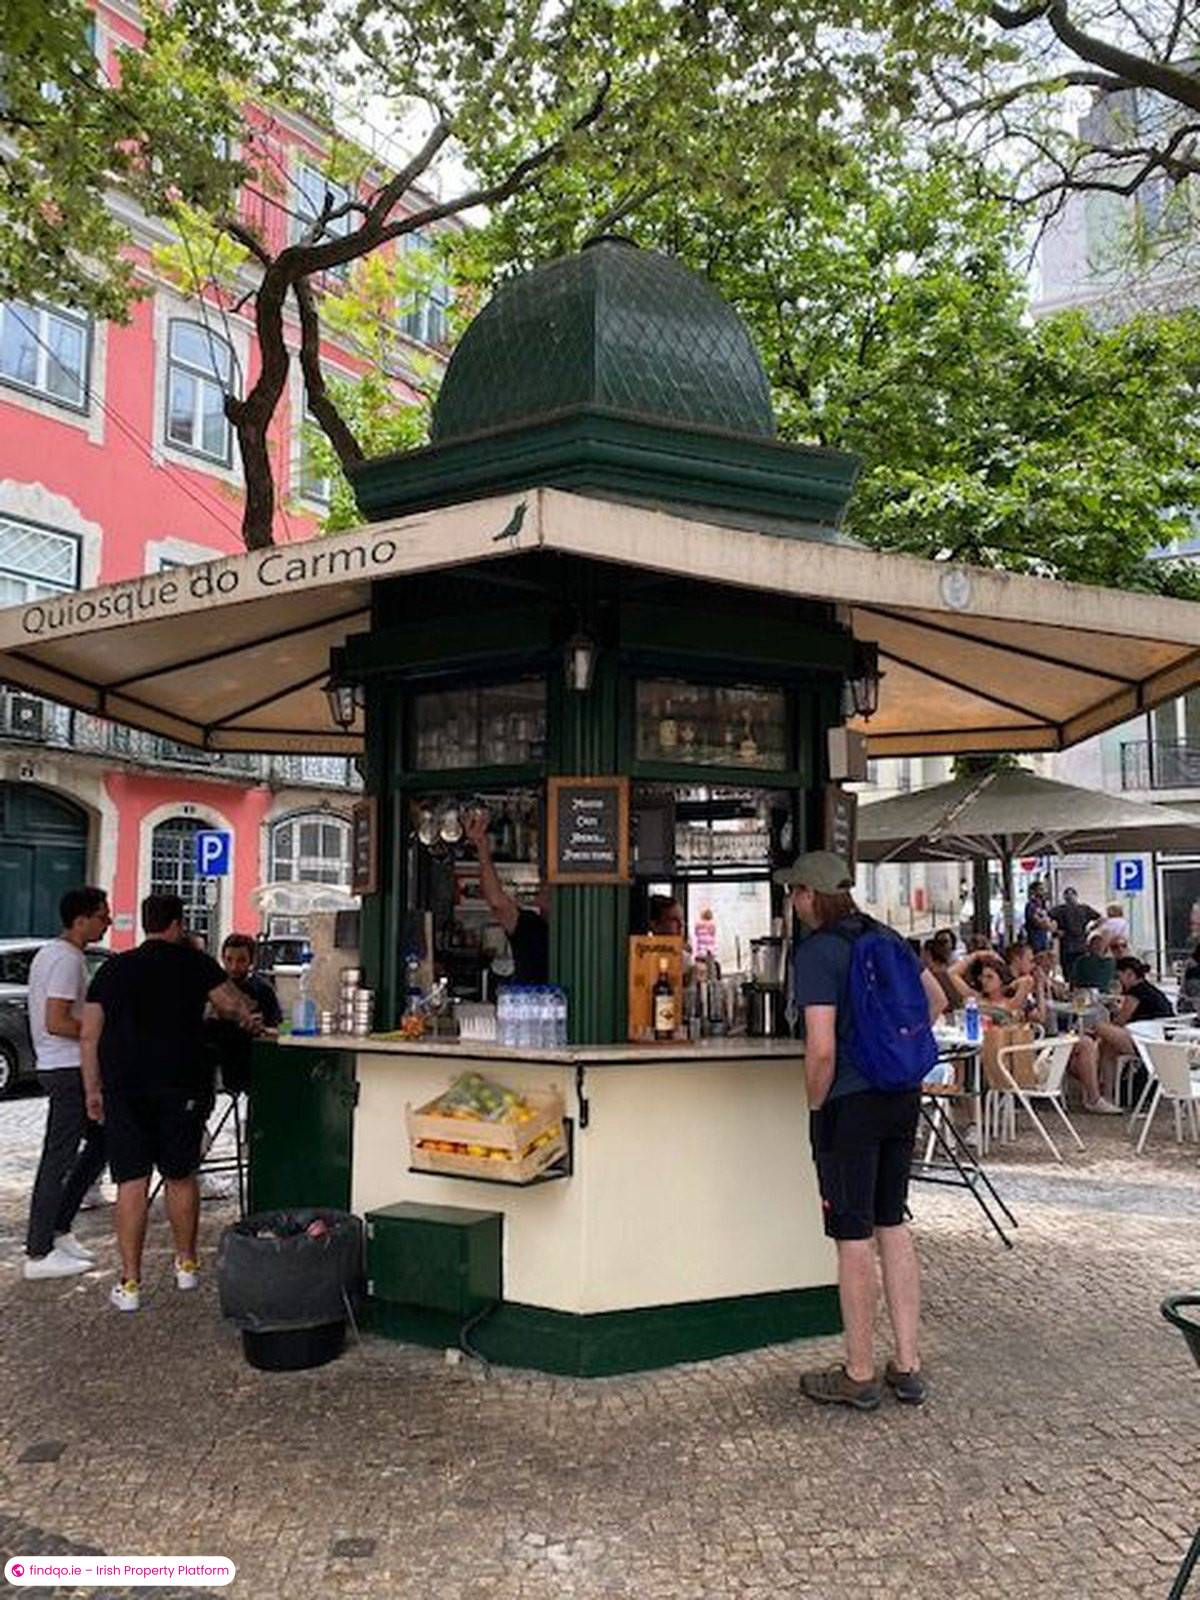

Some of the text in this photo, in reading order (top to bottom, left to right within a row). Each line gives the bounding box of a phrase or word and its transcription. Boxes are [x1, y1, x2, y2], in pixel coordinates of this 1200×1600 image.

[22, 540, 396, 635] Quiosque do Carmo
[202, 835, 223, 873] P
[1120, 862, 1138, 888] P
